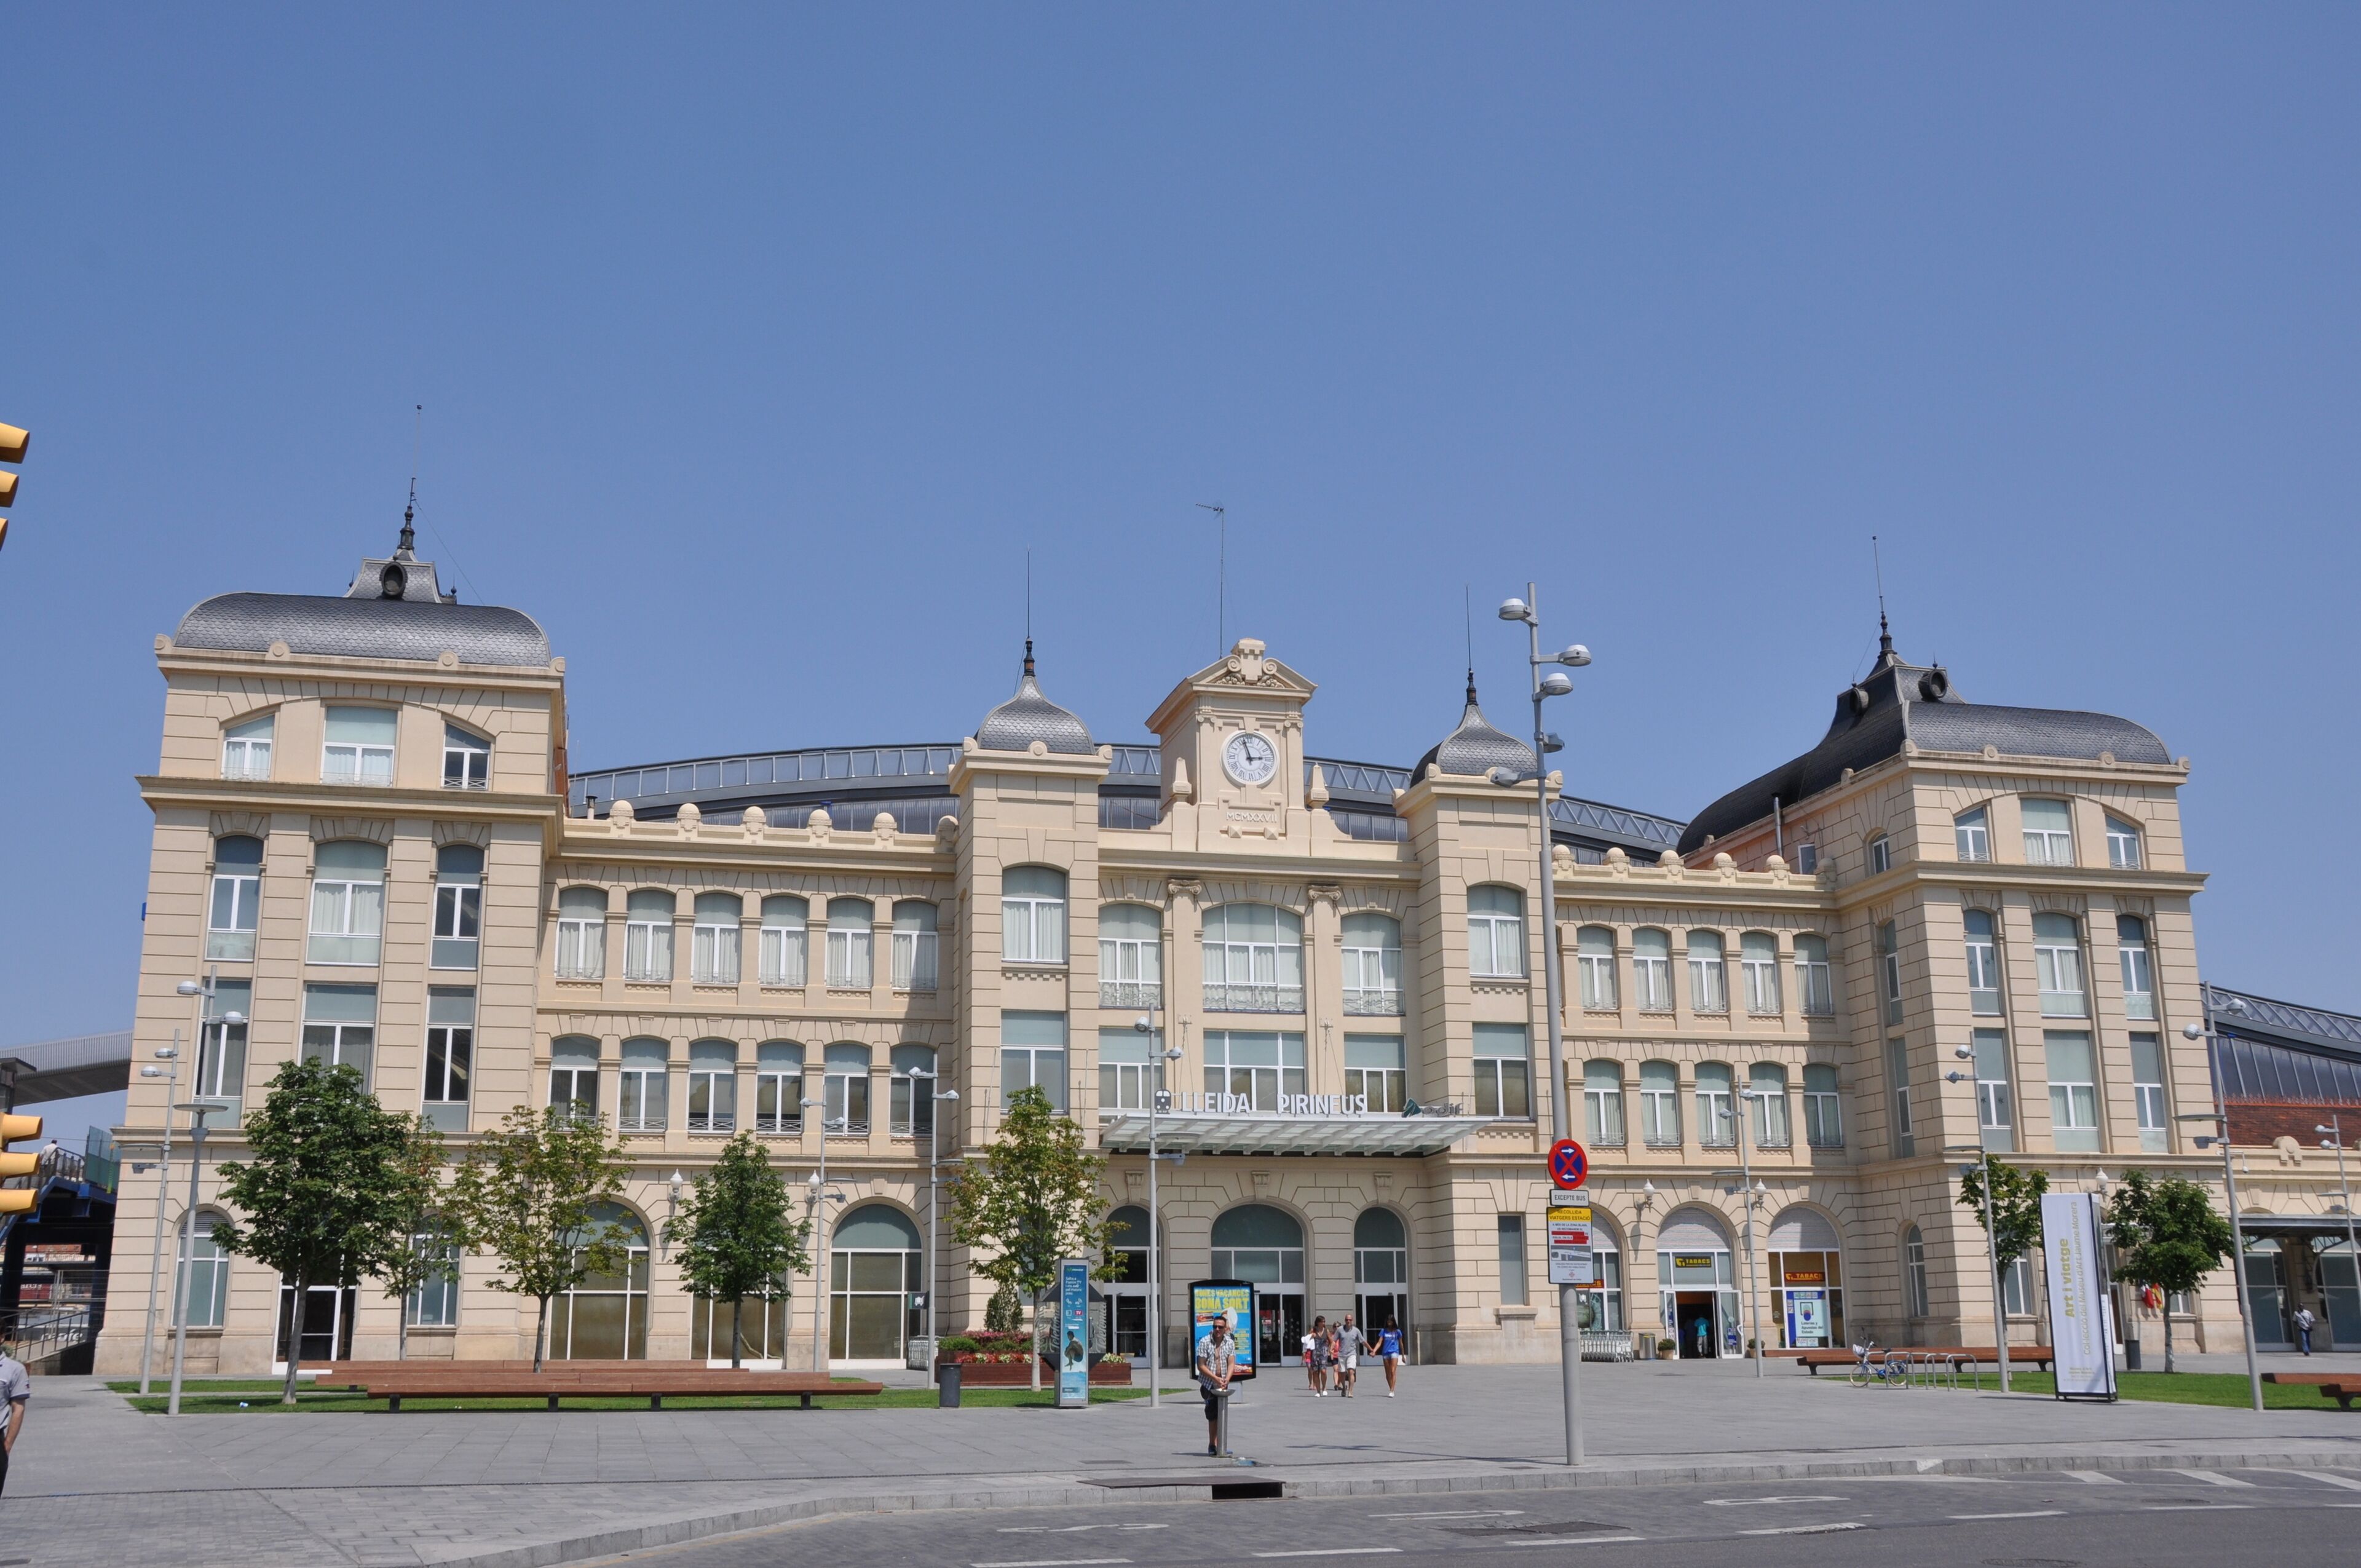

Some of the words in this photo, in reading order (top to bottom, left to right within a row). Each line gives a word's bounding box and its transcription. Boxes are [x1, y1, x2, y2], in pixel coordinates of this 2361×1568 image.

[1226, 812, 1277, 823] MCMXXVII
[1181, 1091, 1251, 1114] LLEIDA
[1277, 1093, 1366, 1115] PIRINEUS
[2071, 1202, 2080, 1229] Morera
[2073, 1230, 2082, 1257] Jaume
[2060, 1238, 2072, 1285] viatge
[2076, 1275, 2086, 1302] Museu
[1195, 1298, 1220, 1309] BONA
[1224, 1298, 1249, 1309] SORT
[2064, 1295, 2076, 1318] Art
[2078, 1302, 2087, 1316] del
